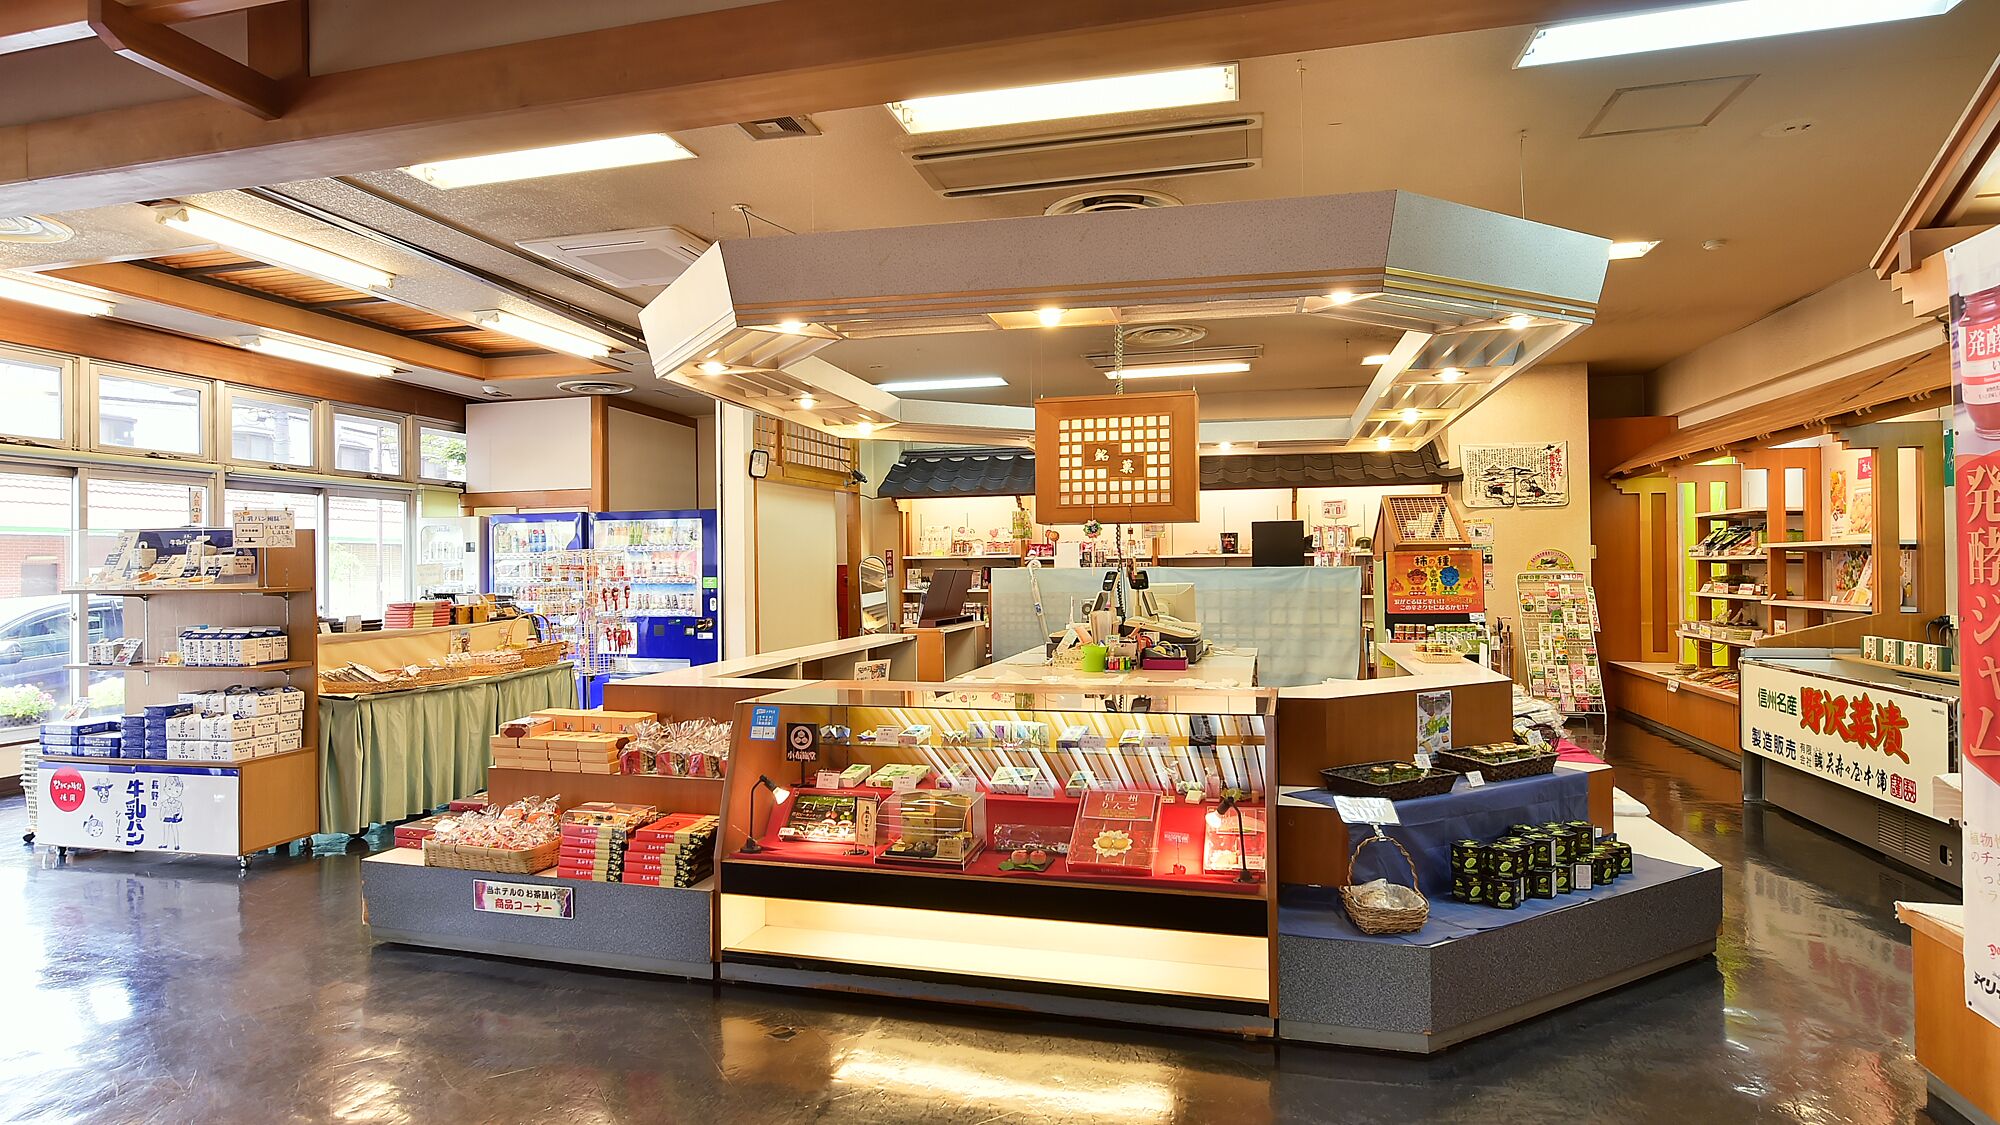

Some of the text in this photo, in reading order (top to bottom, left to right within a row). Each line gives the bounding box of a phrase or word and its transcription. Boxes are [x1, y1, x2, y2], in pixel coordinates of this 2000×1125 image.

[1094, 448, 1135, 475] 銘菓
[1415, 554, 1450, 566] 柿の種
[1758, 686, 1798, 716] 信州名産
[1800, 686, 1910, 765] 野沢菜漬
[1751, 726, 1797, 761] 製造販売
[151, 780, 159, 807] 長野の
[1102, 801, 1137, 810] りんご
[124, 779, 147, 846] 牛乳パン
[496, 898, 552, 912] 商品コーナー
